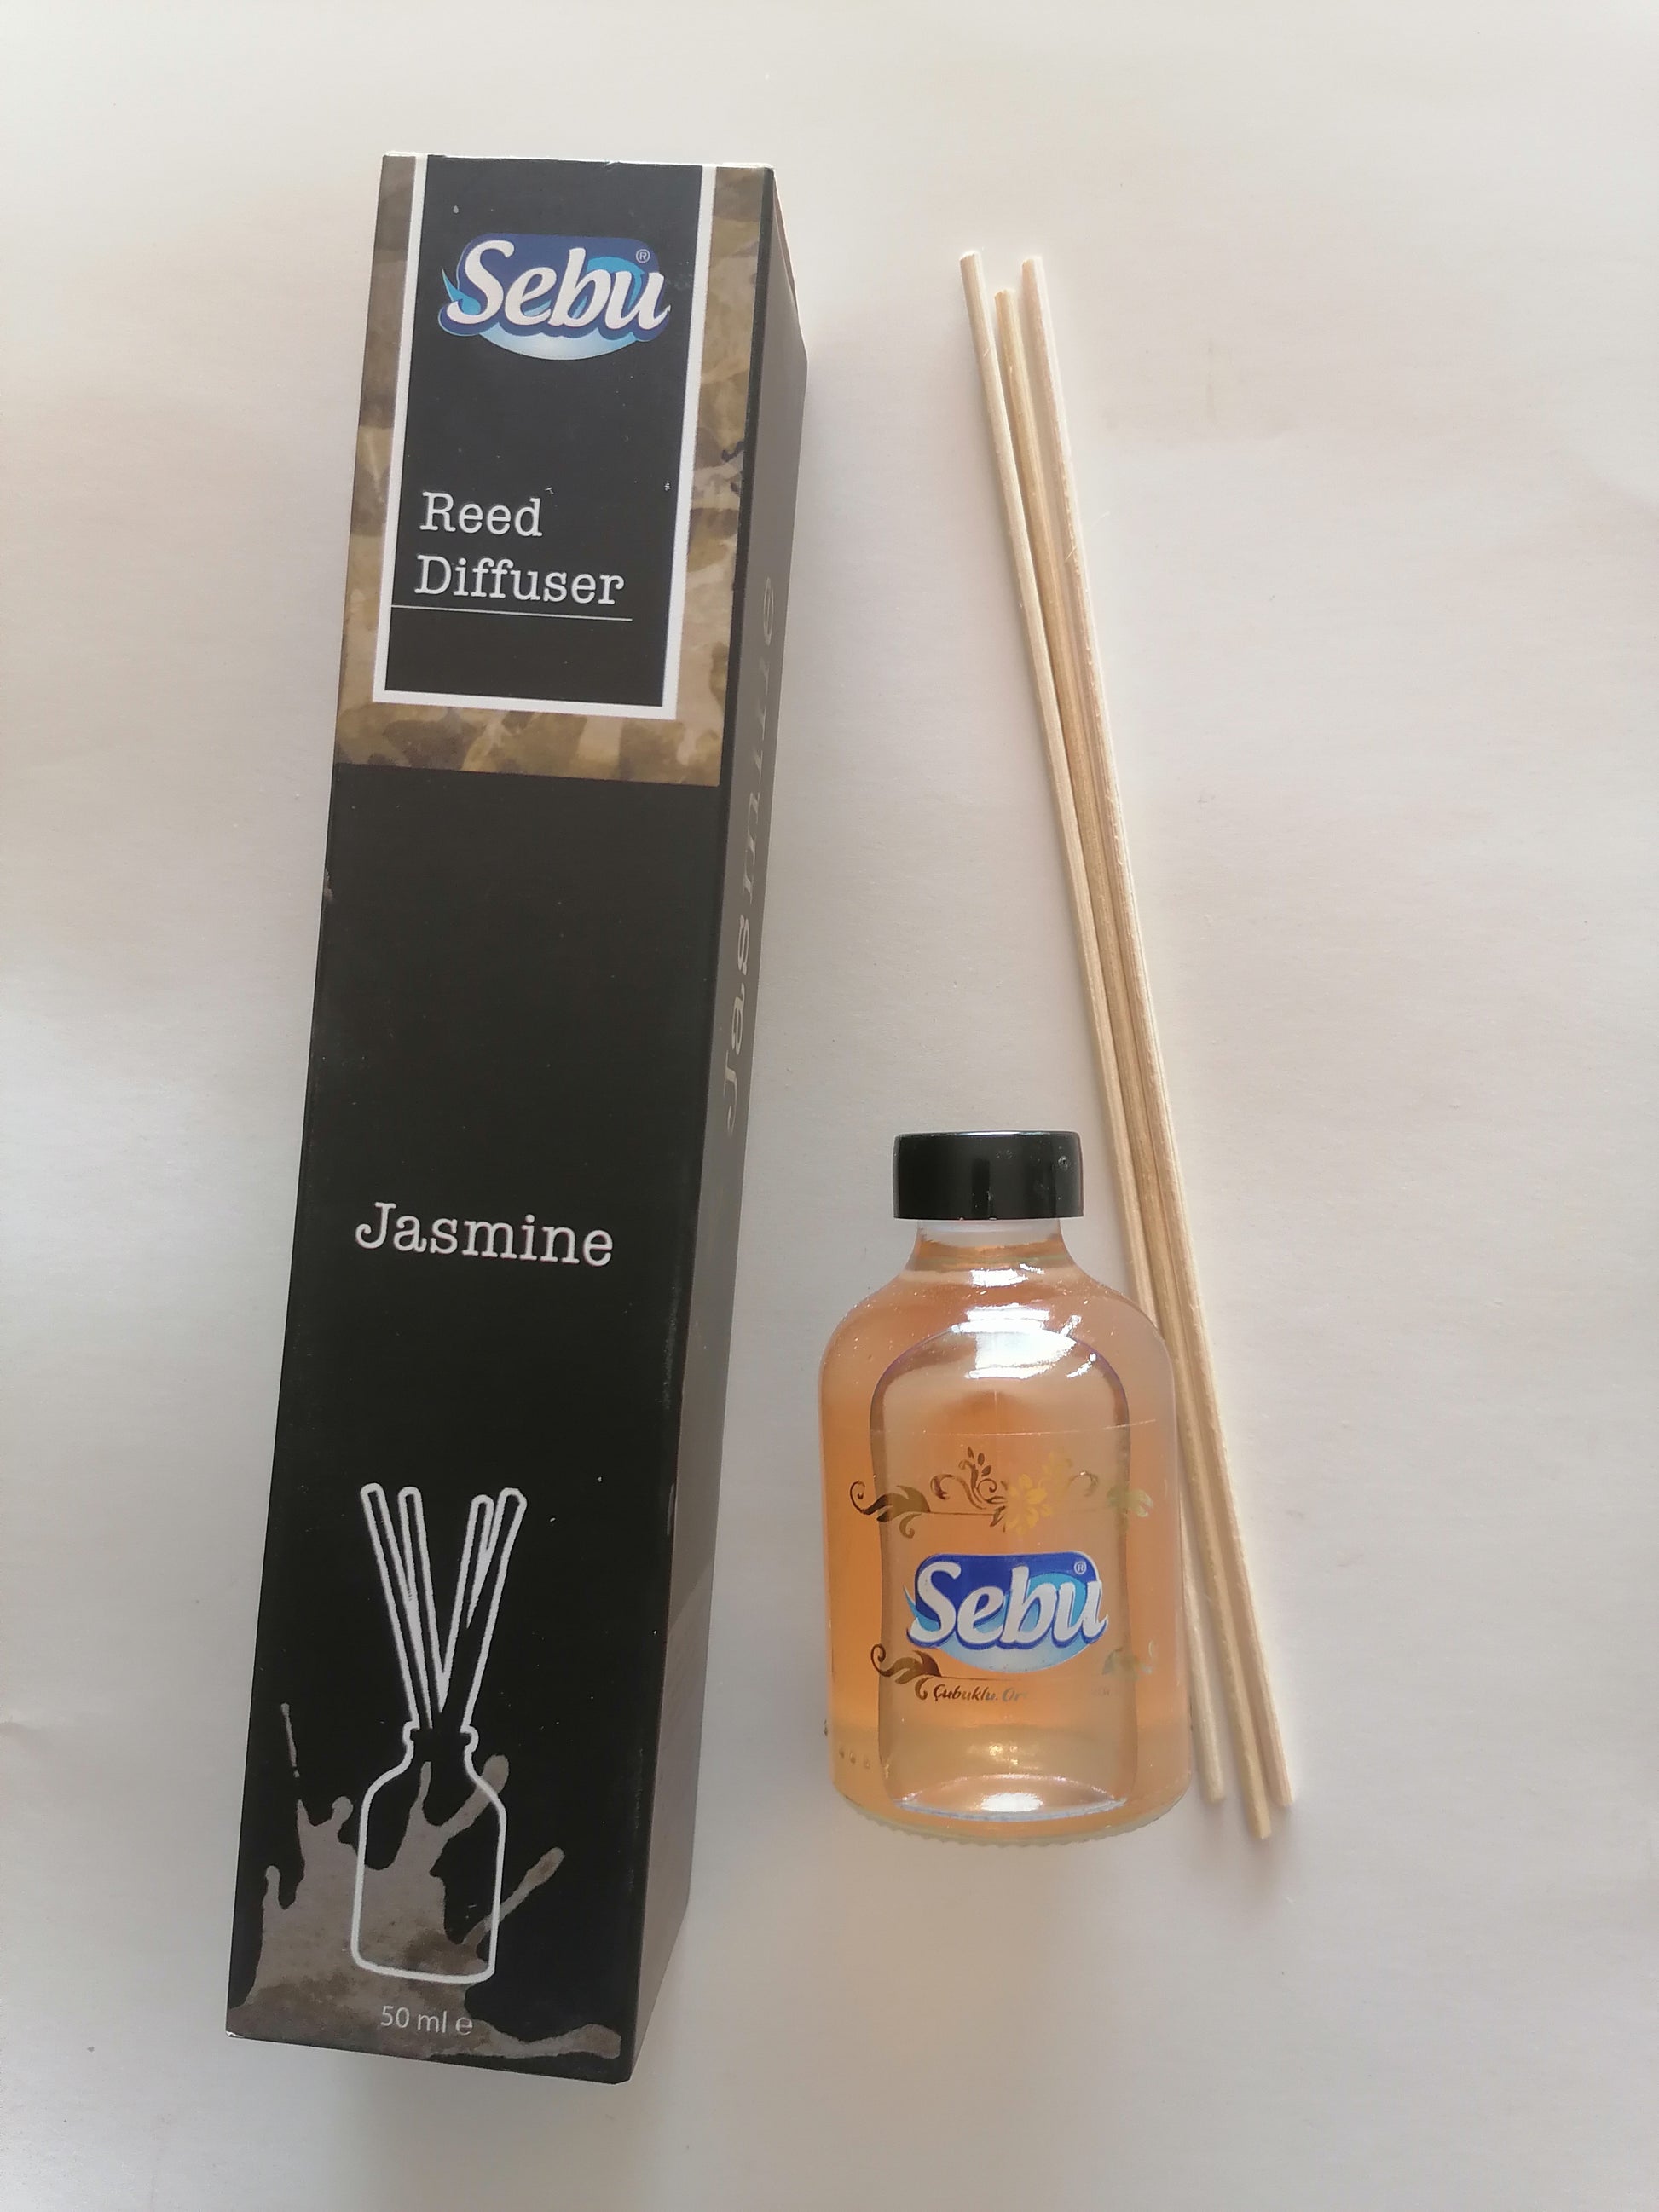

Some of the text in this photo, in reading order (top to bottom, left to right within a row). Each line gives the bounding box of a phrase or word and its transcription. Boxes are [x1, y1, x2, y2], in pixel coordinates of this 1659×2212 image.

[447, 239, 671, 330] Sebu
[419, 491, 542, 539] Reed
[414, 554, 625, 605] Diffuser
[355, 1201, 613, 1267] Jasmine
[907, 1562, 1109, 1647] Sebu
[380, 2005, 410, 2028] 50
[417, 2010, 448, 2033] ml
